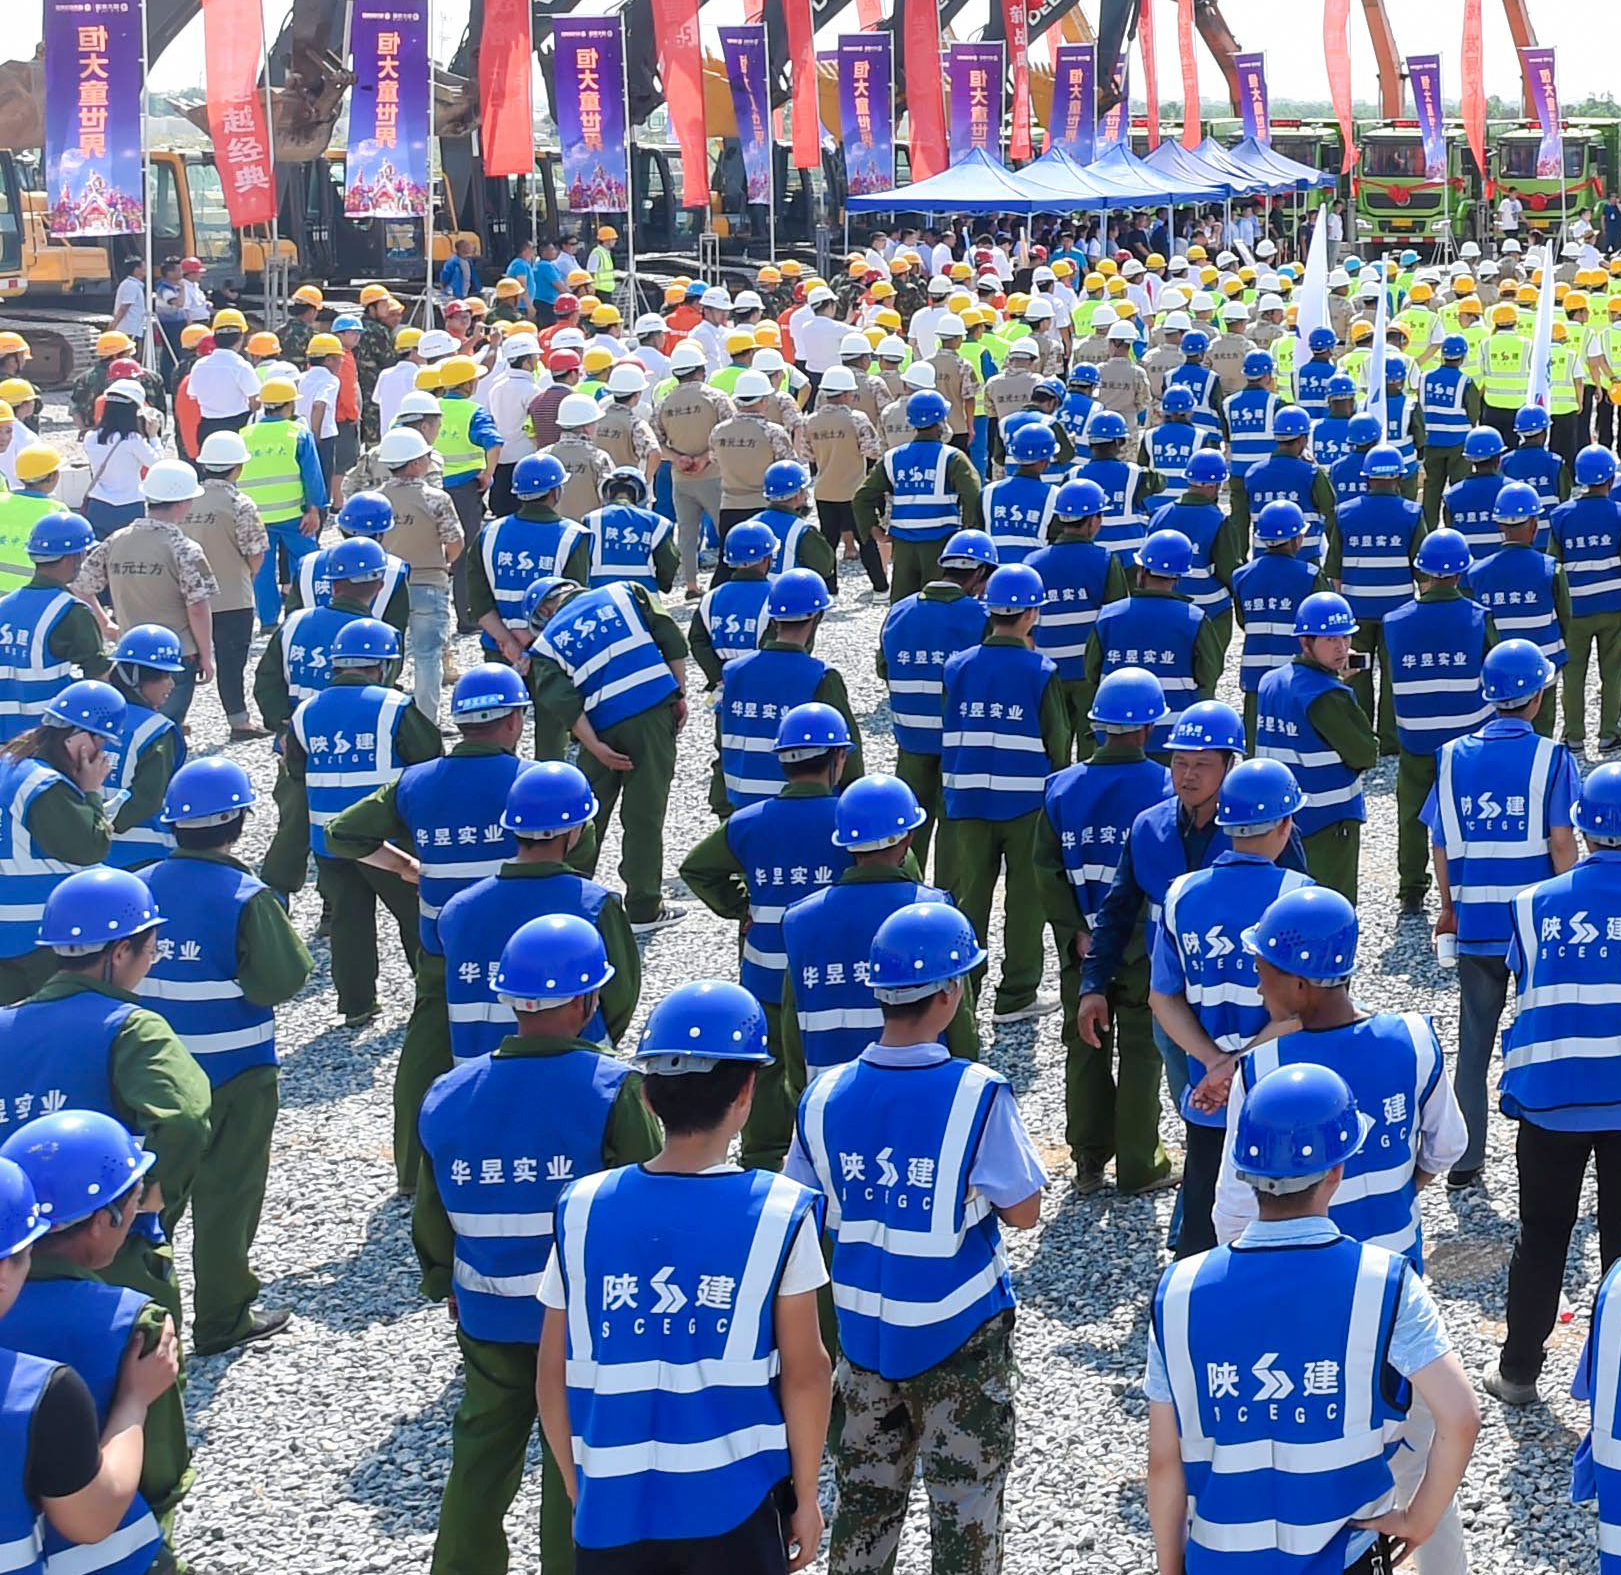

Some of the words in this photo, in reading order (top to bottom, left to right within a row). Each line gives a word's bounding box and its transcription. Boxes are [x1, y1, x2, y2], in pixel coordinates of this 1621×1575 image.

[1107, 649, 1176, 664] 华昱实业
[1402, 650, 1467, 667] 华昱实业
[960, 702, 1024, 721] 华昱实业
[417, 825, 503, 845] 华昱实业
[756, 867, 833, 886] 华昱实业
[451, 1155, 574, 1184] 华昱实业
[839, 1147, 935, 1189] 陕建
[602, 1267, 736, 1314] 陕建
[602, 1320, 728, 1337] SCEGC
[1208, 1353, 1339, 1401] 陕建
